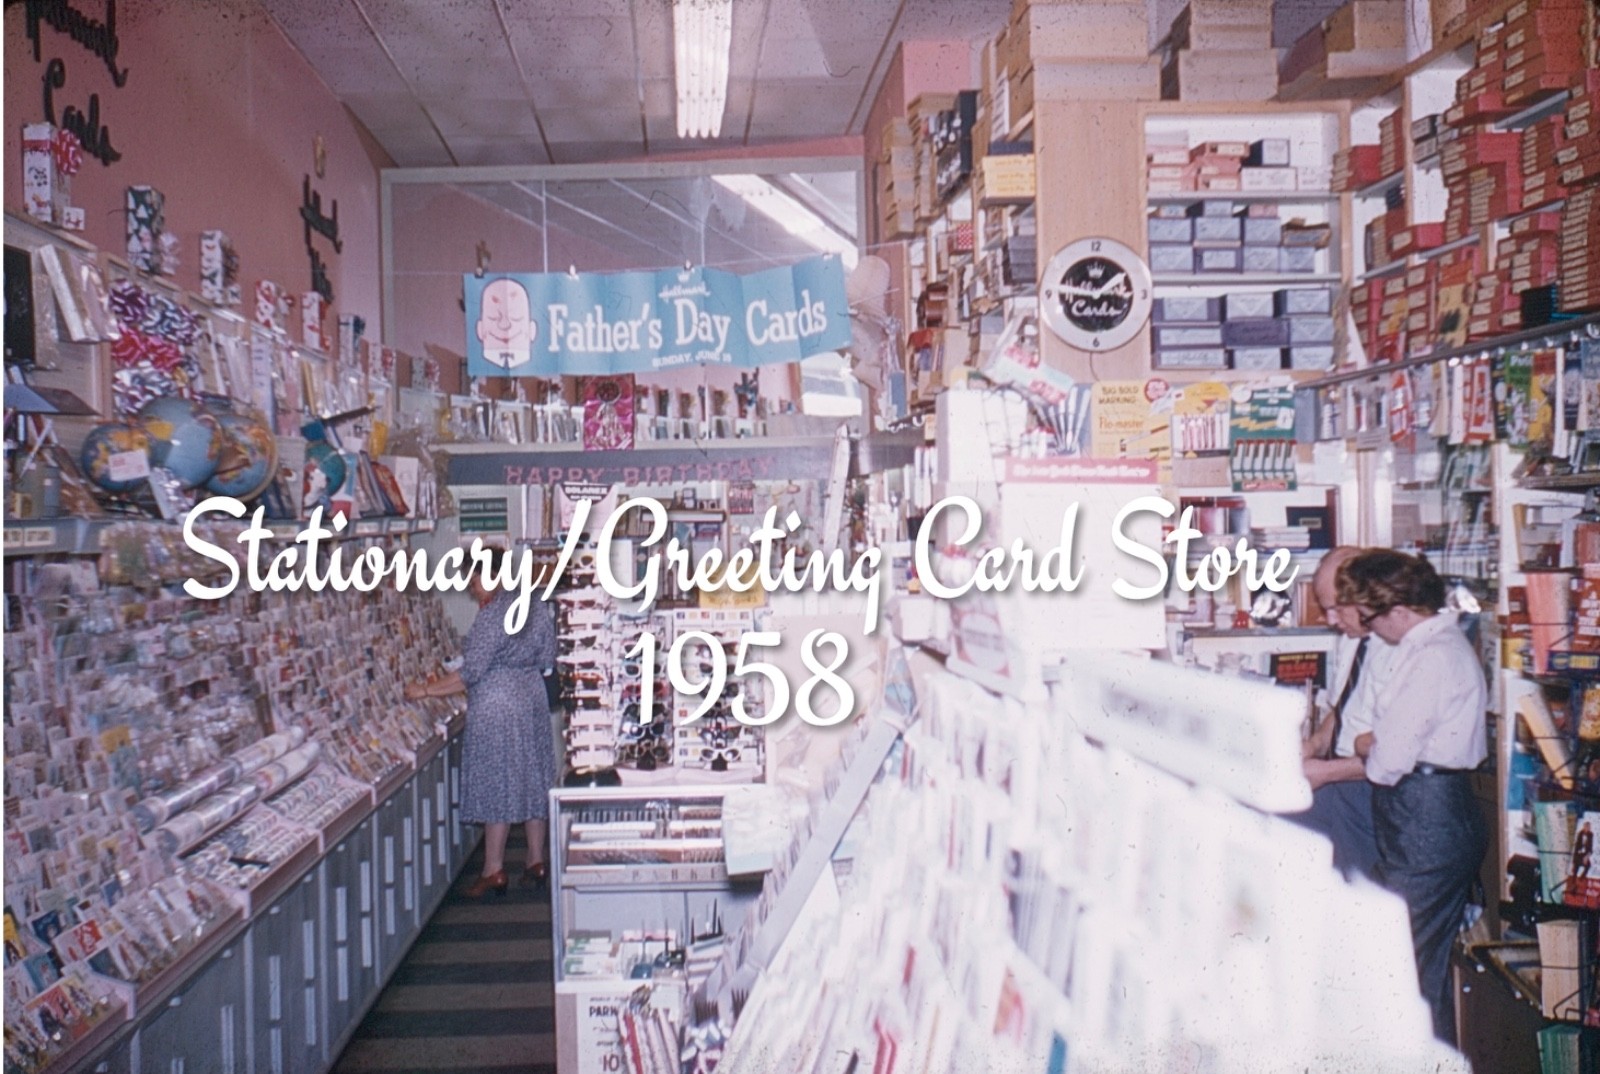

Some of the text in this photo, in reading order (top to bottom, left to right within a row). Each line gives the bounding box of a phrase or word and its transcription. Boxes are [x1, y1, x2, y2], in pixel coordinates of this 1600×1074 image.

[1091, 241, 1102, 252] 12
[1044, 289, 1053, 300] 9
[1141, 288, 1149, 300] 3
[1070, 299, 1125, 318] Cards
[547, 289, 828, 354] Father's Day Cards
[1092, 337, 1101, 349] 6
[1118, 385, 1139, 395] BOLD
[505, 456, 774, 488] HAPPY BIRTHDAY
[589, 1005, 619, 1018] PARK
